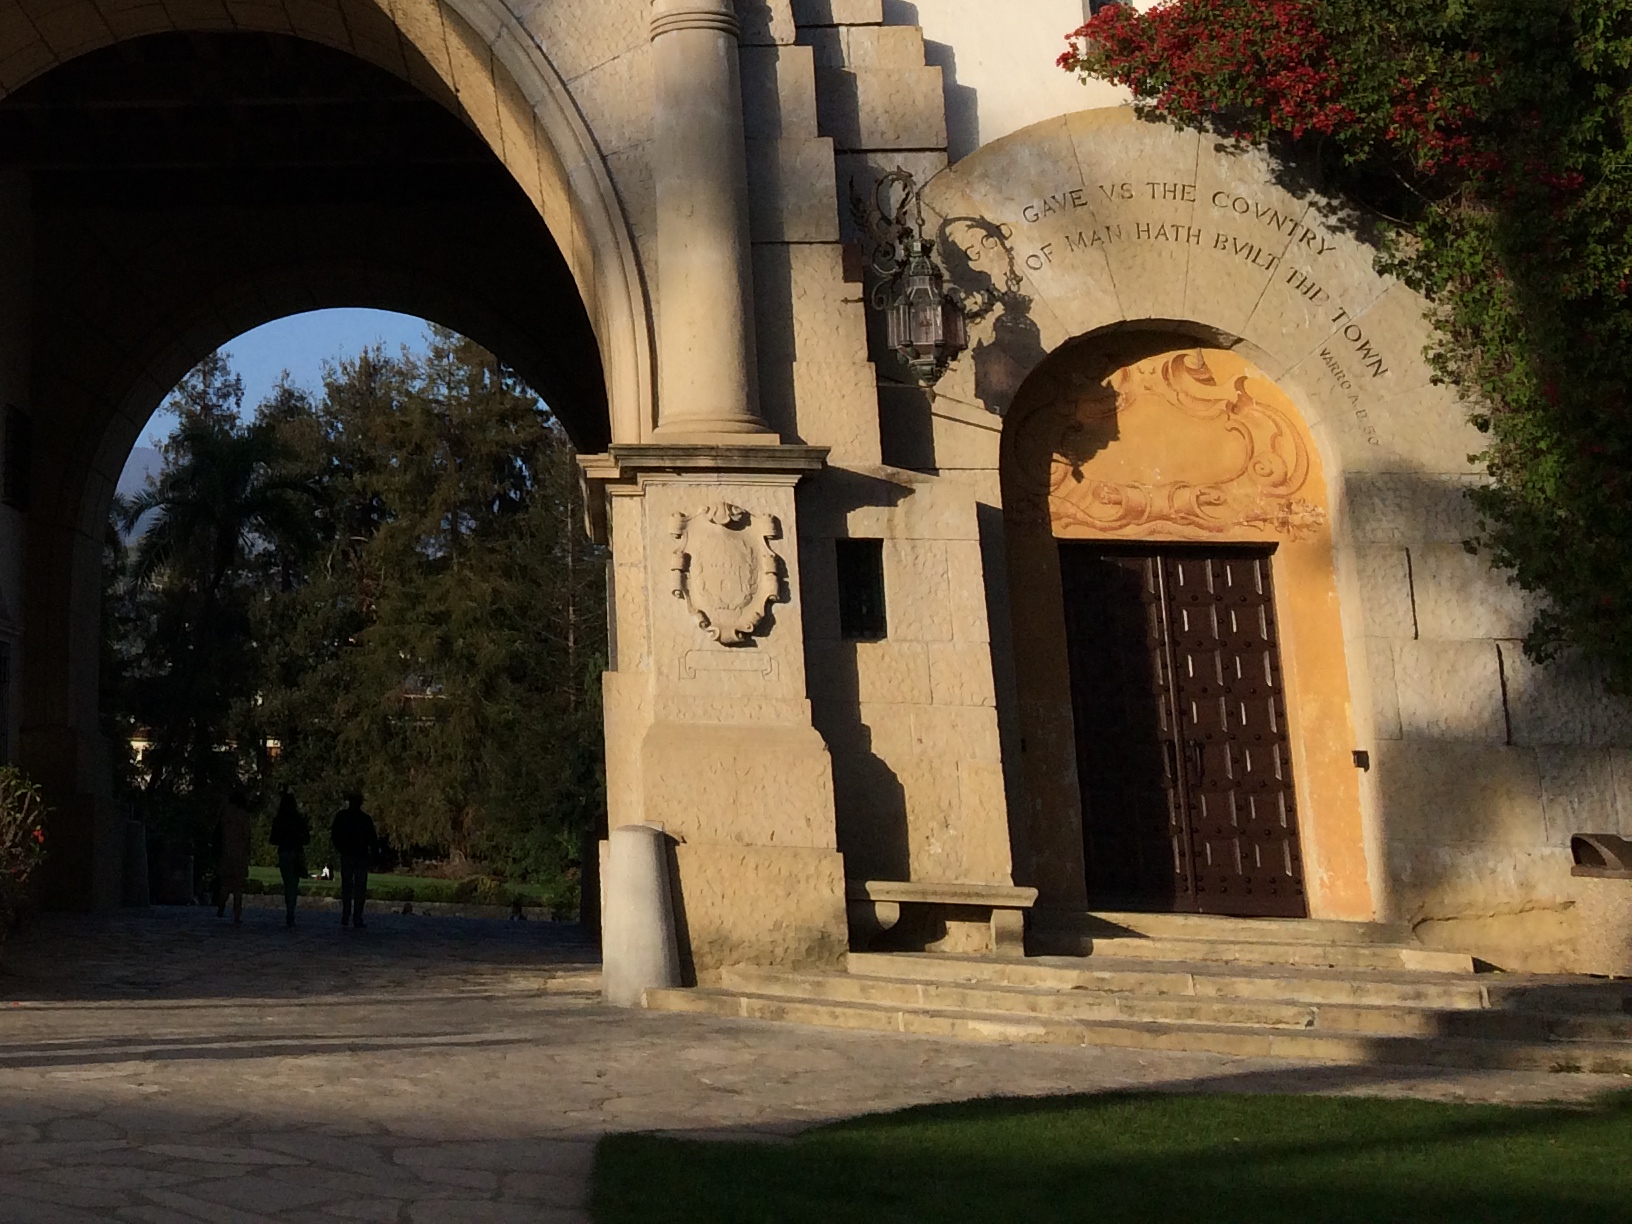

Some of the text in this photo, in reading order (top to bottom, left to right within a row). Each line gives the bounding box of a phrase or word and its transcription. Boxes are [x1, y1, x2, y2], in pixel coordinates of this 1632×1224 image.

[964, 181, 1337, 262] GOD GAVE VS THE COVNTRY
[1025, 221, 1389, 379] OF MAN HATH BVILT THE TOWN
